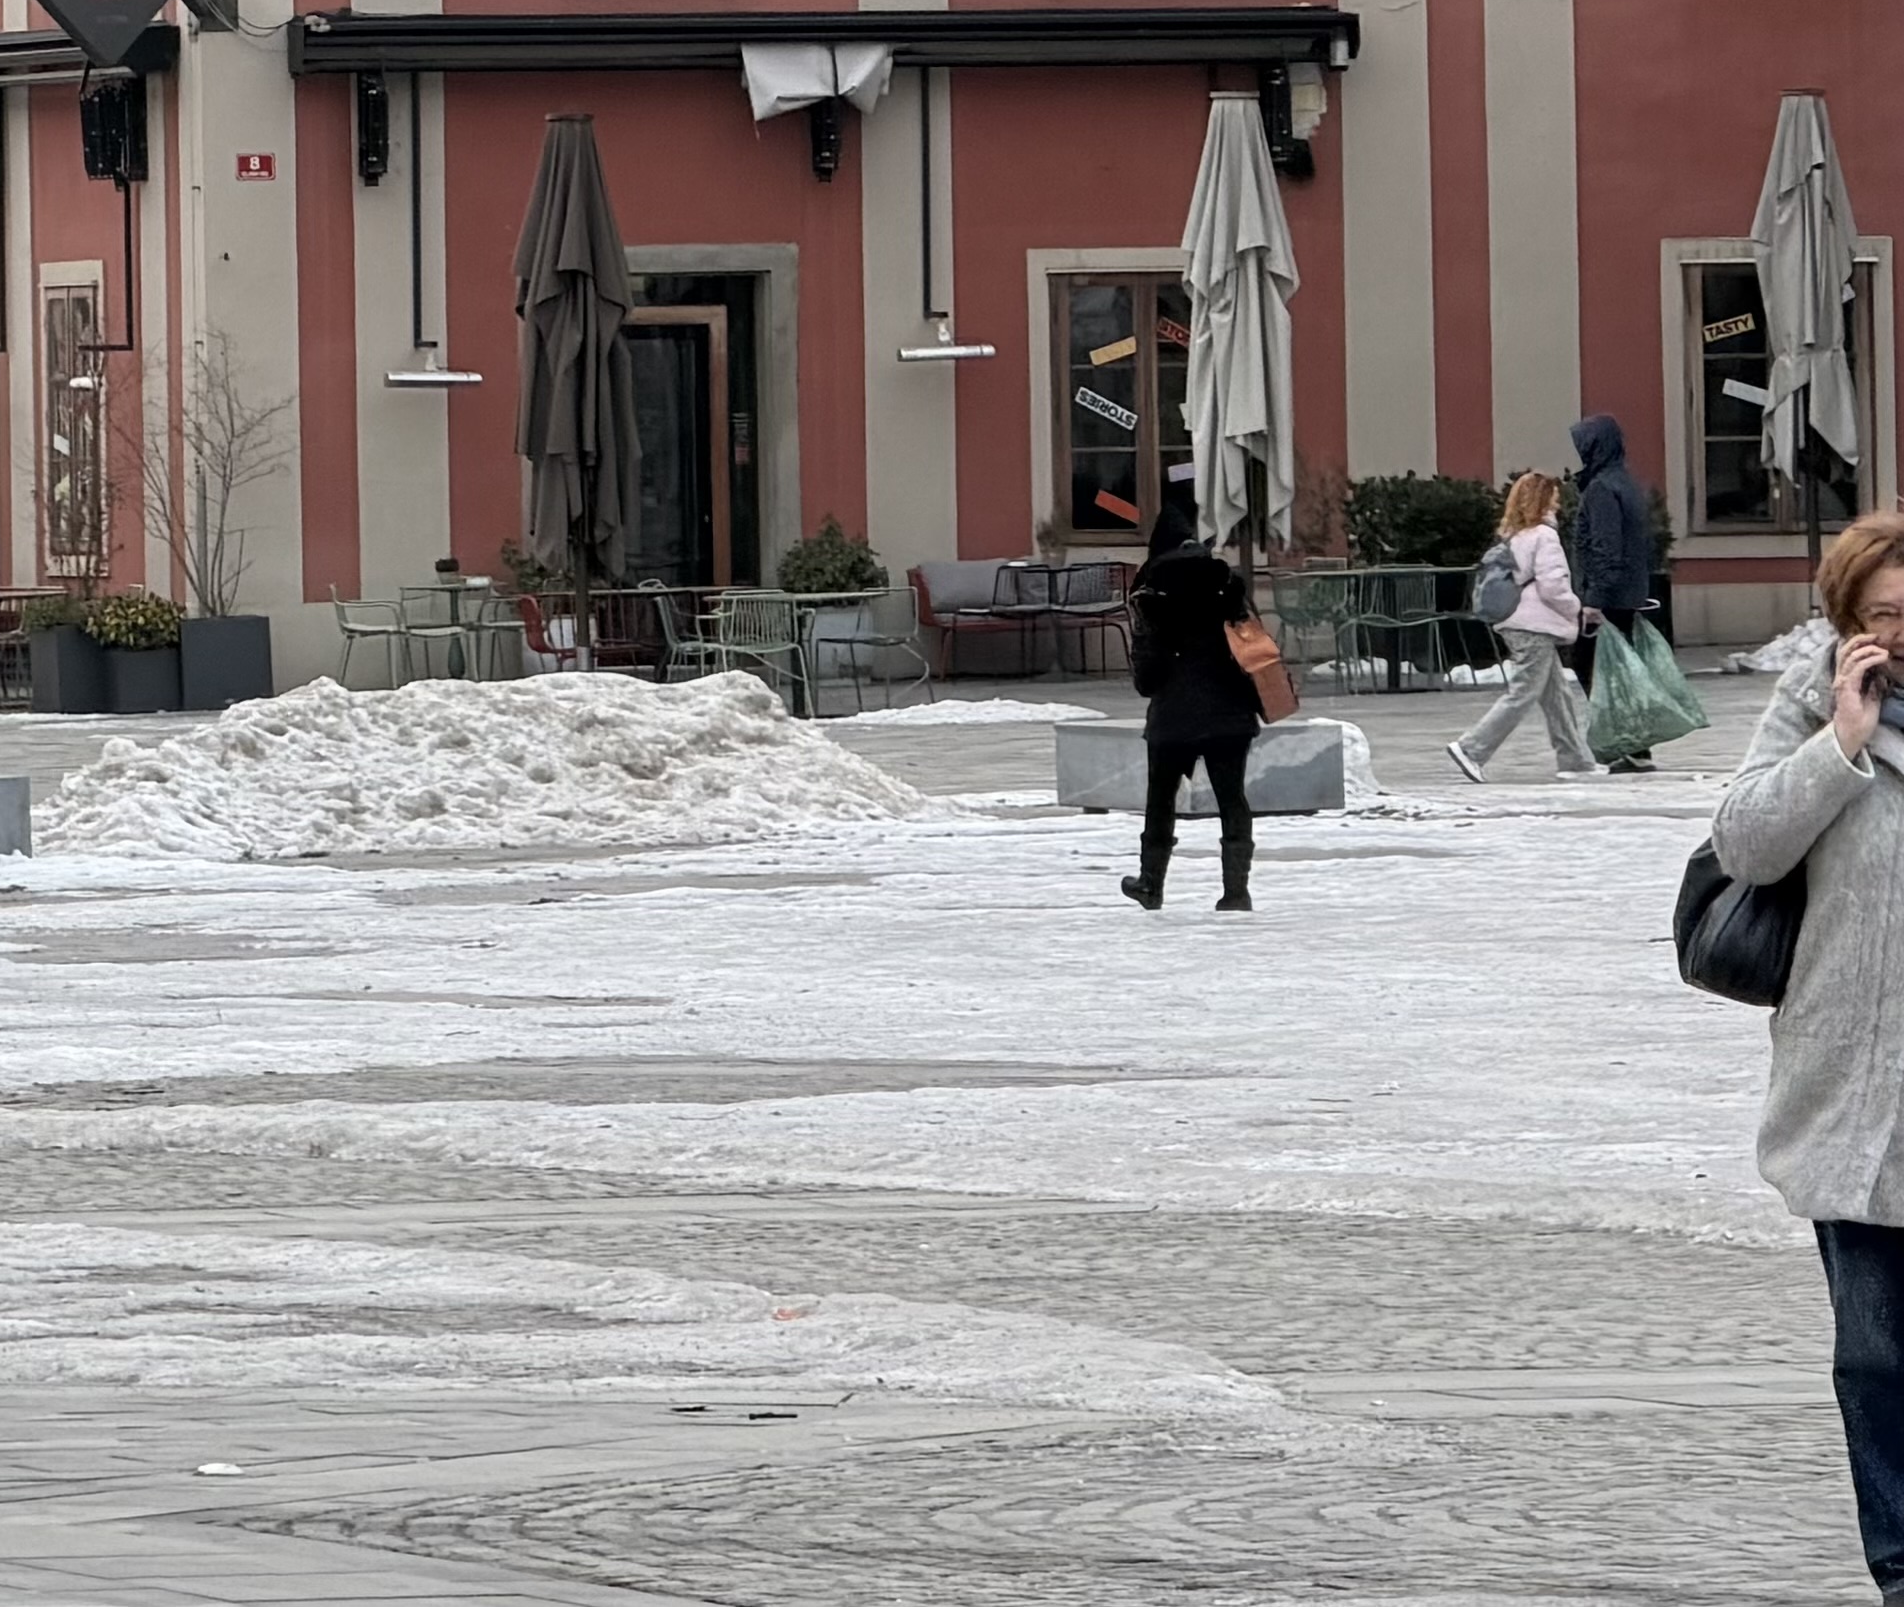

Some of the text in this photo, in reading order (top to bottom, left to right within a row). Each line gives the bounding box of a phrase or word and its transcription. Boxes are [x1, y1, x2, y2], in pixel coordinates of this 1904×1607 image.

[249, 156, 260, 170] 8
[1705, 317, 1751, 339] TASTY
[1078, 389, 1136, 428] STORIES
